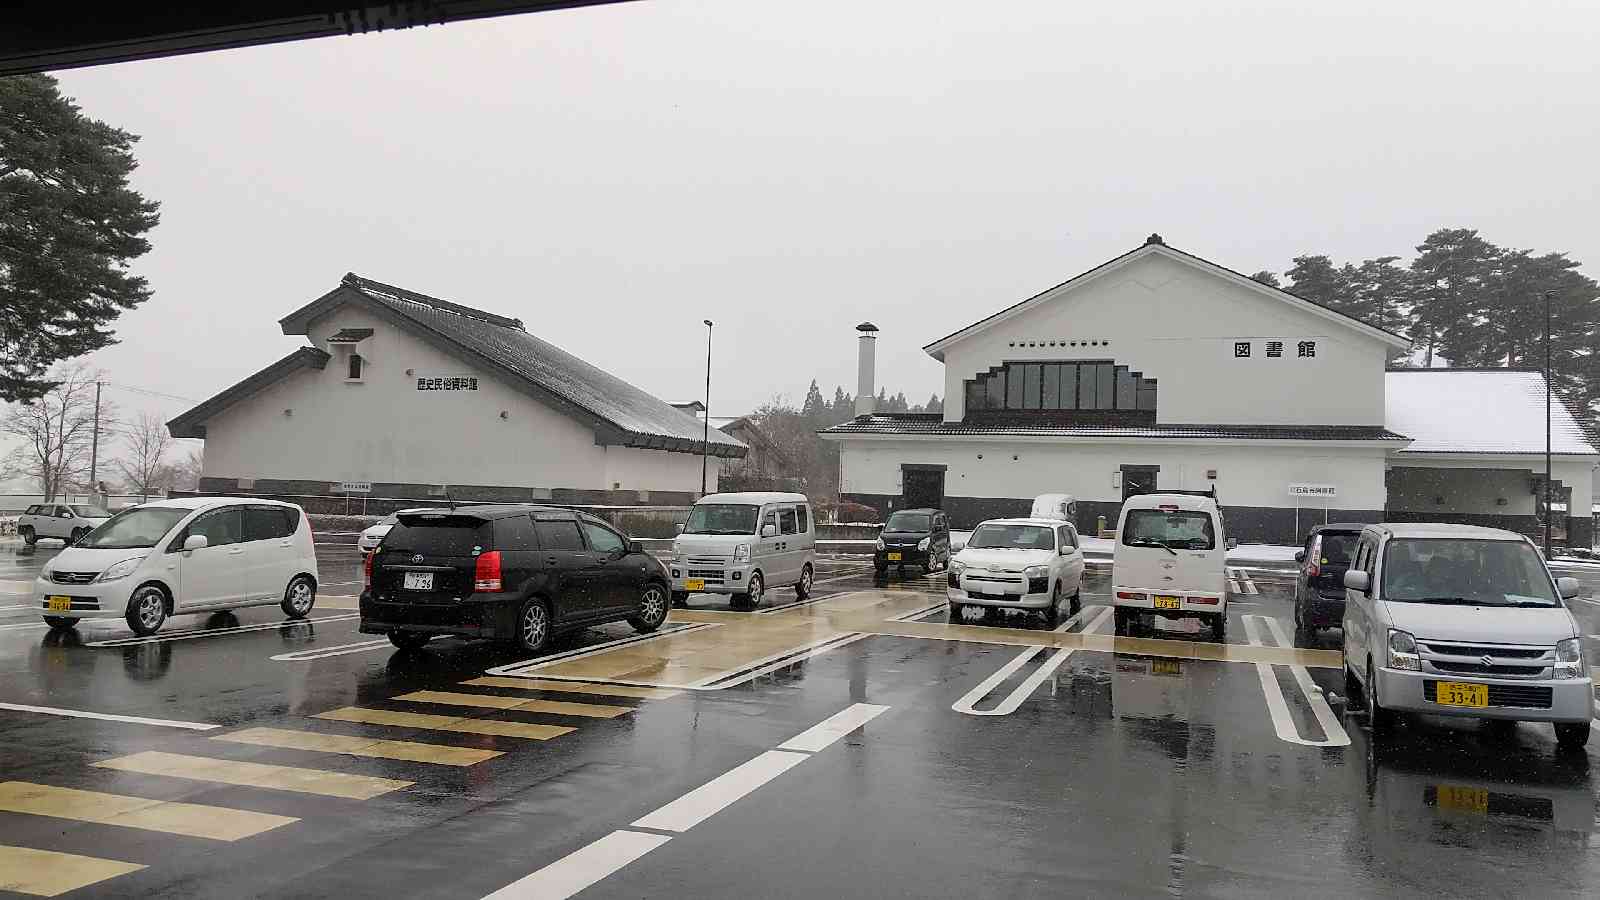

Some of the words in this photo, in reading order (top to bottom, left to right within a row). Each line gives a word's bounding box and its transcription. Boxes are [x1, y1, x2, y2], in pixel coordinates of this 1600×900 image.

[1235, 341, 1316, 358] 図書館
[417, 377, 478, 391] 歴史民俗資料館
